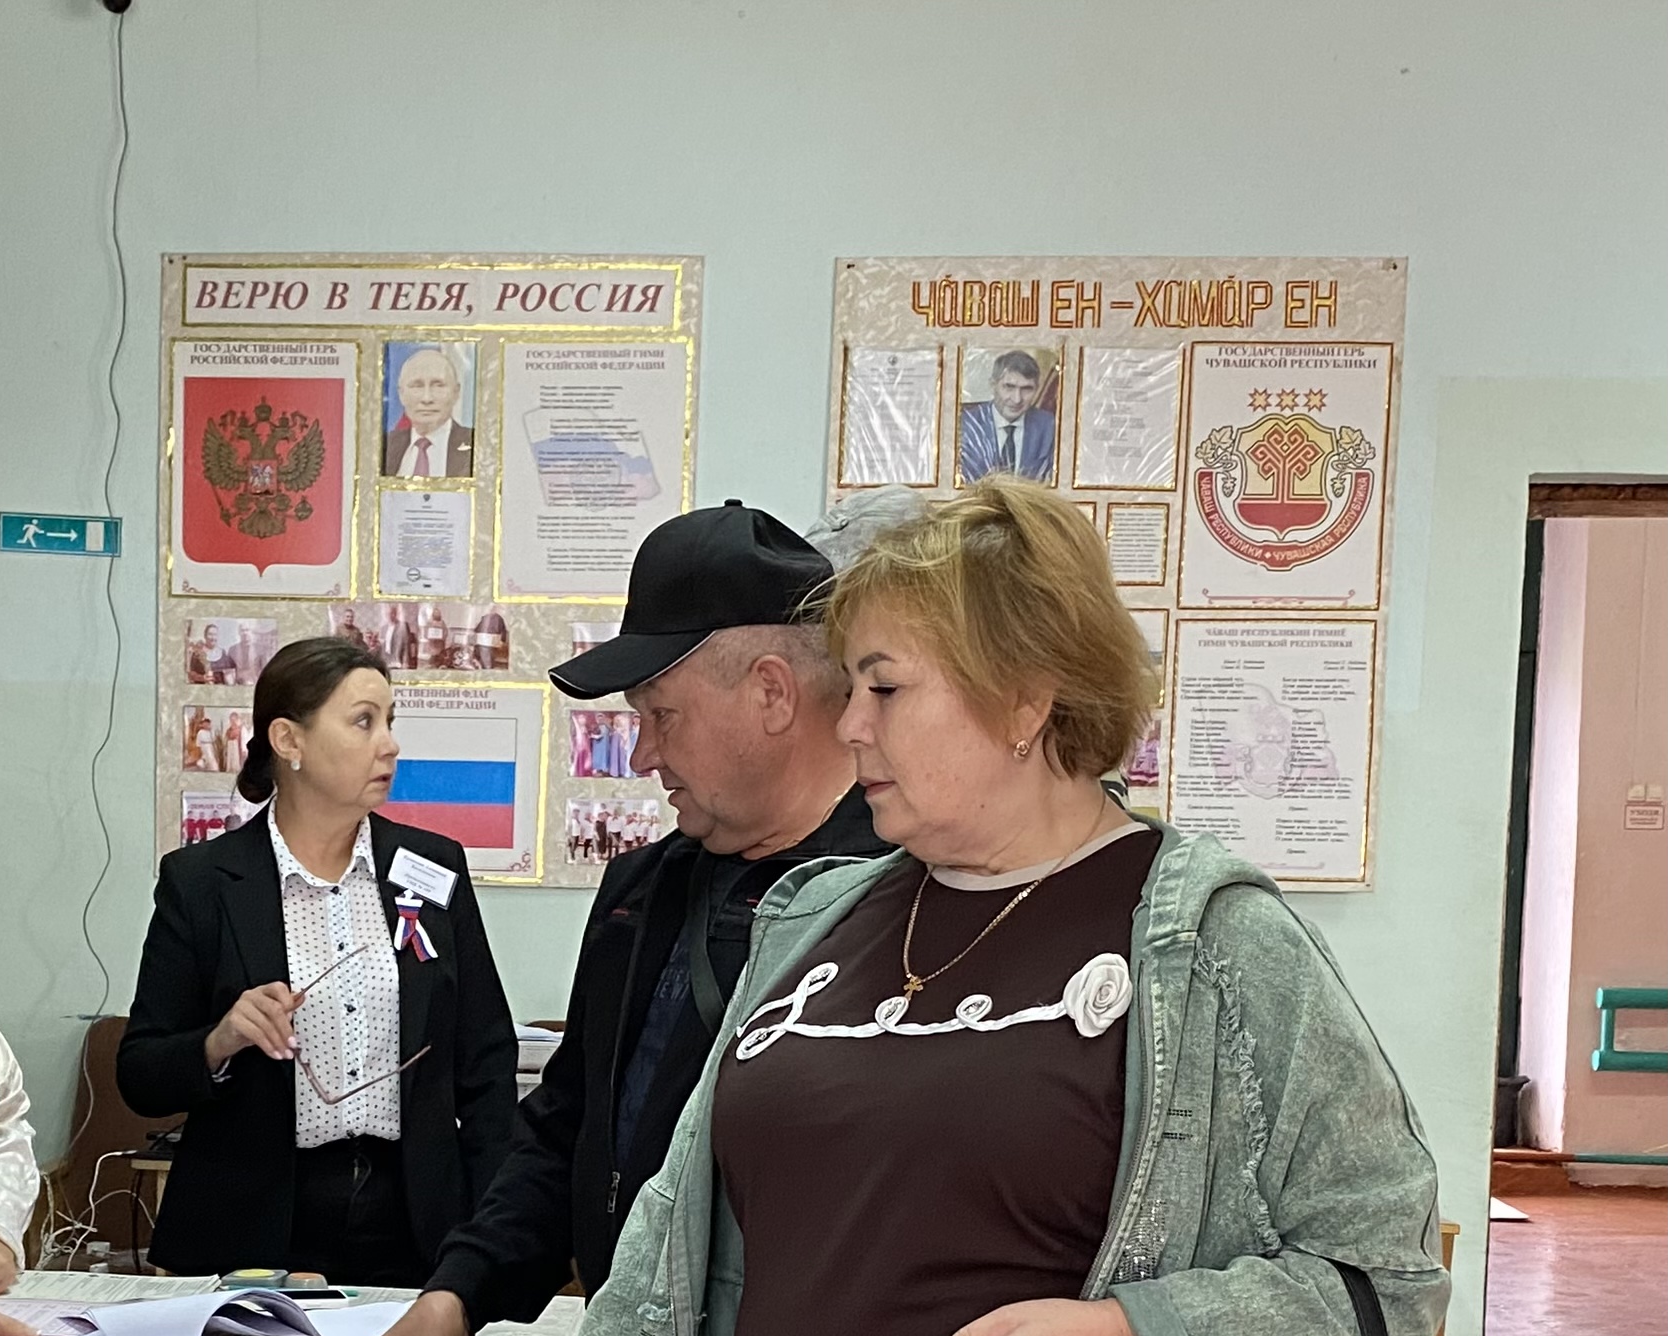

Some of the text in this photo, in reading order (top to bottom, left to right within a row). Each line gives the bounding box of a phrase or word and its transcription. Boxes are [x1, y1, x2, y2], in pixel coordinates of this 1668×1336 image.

[194, 280, 664, 317] ВЕРЮ В ТЕБЯ, РОССИЯ
[1050, 280, 1101, 328] ЕН
[1284, 280, 1338, 328] ЕН
[193, 343, 337, 354] ГОСУДАРСТВЕННЫЙ ГЕРБ
[526, 349, 665, 359] ГОСУДАРСТВЕННЫЙ ГИМН
[1218, 346, 1335, 357] ГОСУДАРСТВЕННЫЙ
[190, 354, 340, 366] РОССИЙСКОЙ ФЕДЕРАЦИИ
[525, 360, 666, 371] РОССИЙСКОЙ ФЕДЕРАЦИИ
[1205, 357, 1378, 369] ЧУВАШСКОЙ РЕСПУБЛИКИ
[1272, 535, 1335, 560] ЧУВАШСКАЯ
[393, 688, 460, 698] РСТВЕННЫЙ
[426, 700, 497, 711] ФЕДЕРАЦИИ
